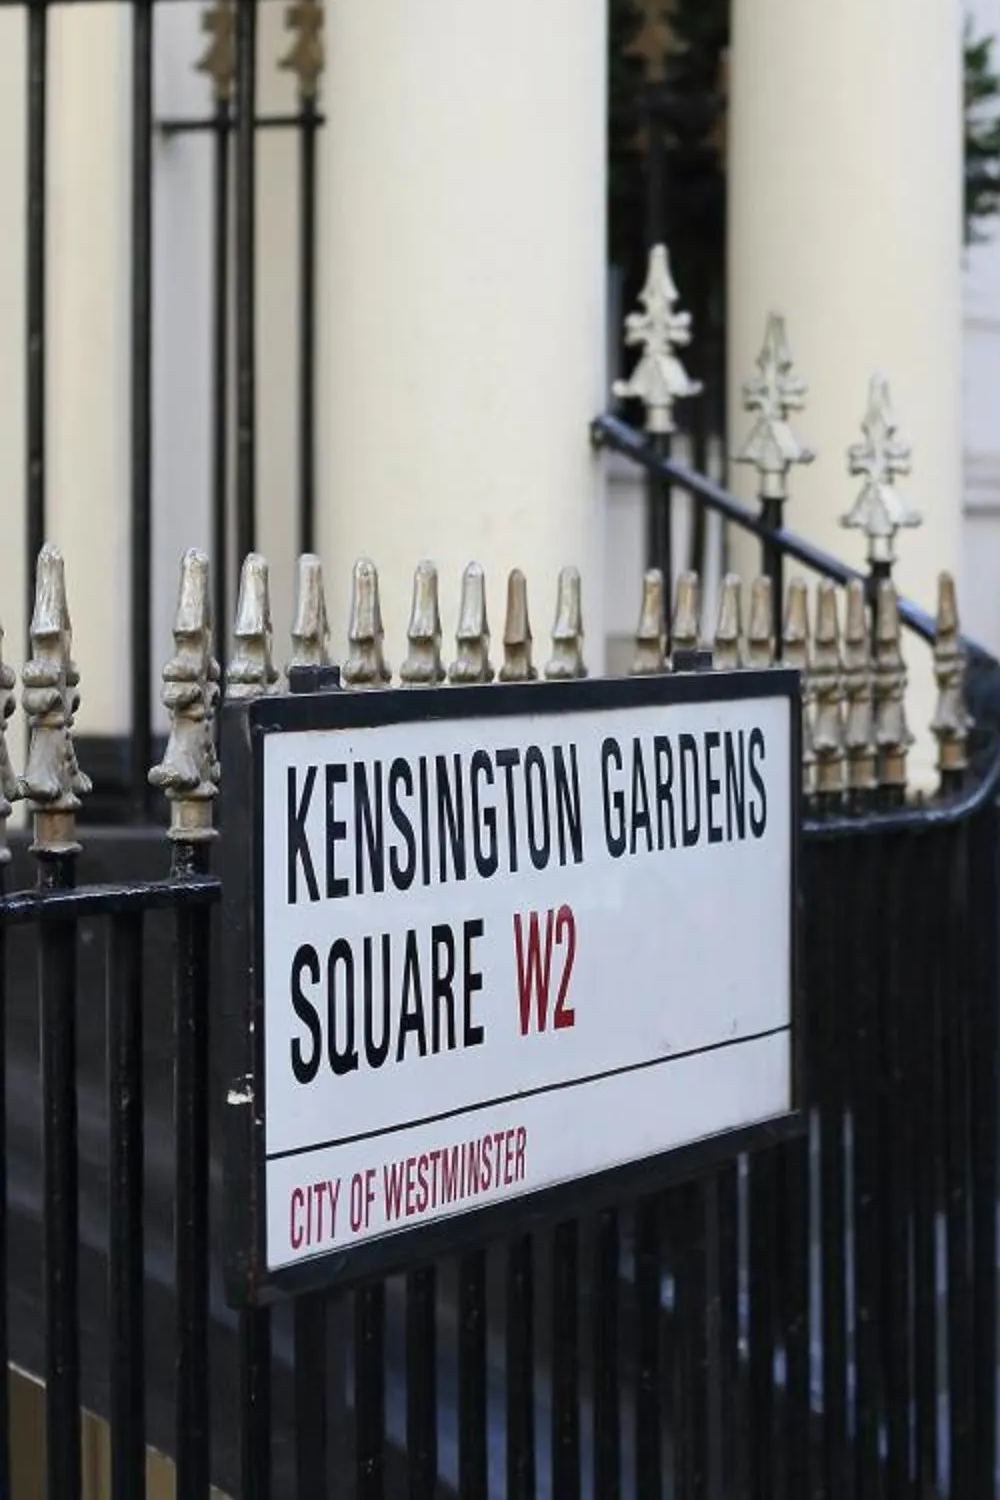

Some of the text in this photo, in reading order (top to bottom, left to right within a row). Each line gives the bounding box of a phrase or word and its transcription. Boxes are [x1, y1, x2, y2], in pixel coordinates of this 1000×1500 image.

[287, 727, 767, 904] KENSINGTON GARDENS
[290, 904, 576, 1085] SQUARE W2
[290, 1126, 527, 1250] CITY OF WESTMINSTER
